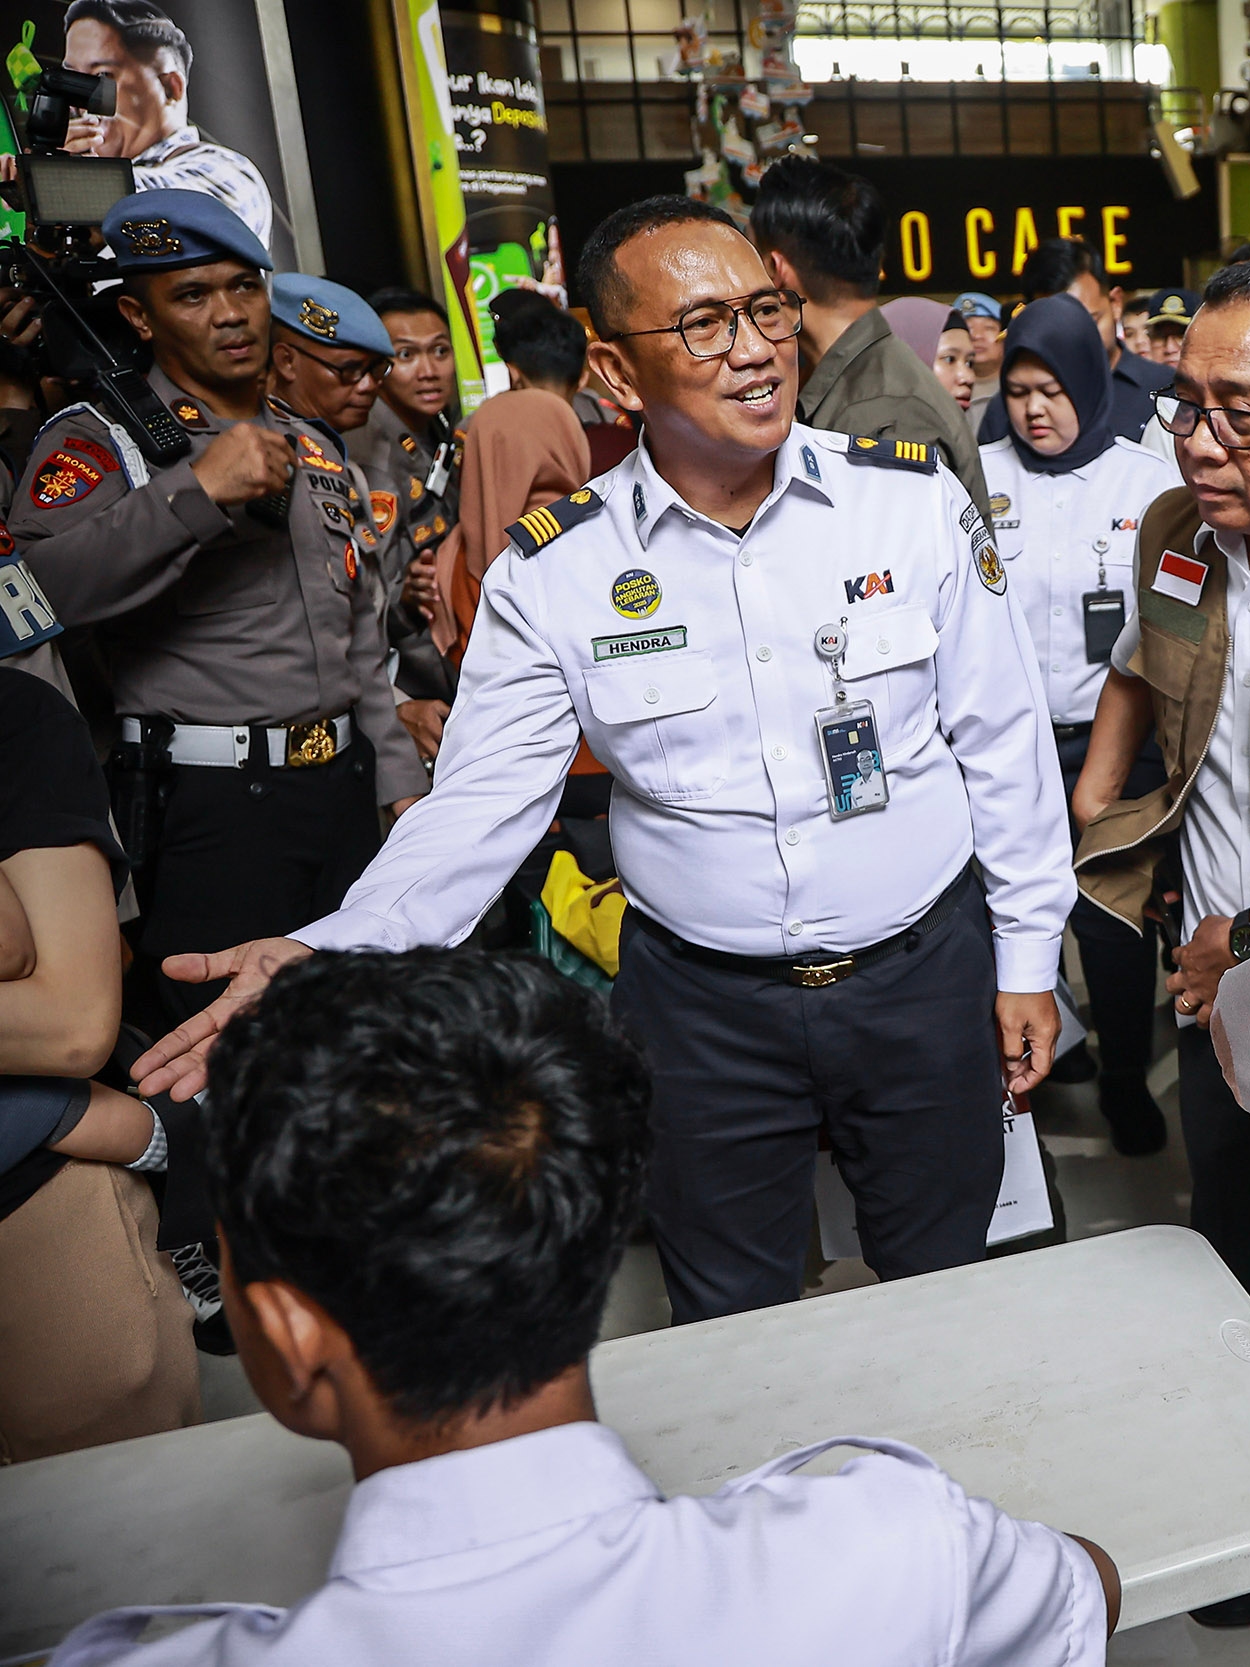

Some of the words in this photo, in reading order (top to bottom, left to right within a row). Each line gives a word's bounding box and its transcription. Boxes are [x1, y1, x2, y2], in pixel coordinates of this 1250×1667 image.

[965, 205, 1133, 280] CAFE
[56, 453, 100, 481] PROPAM
[615, 575, 652, 594] POSKO
[615, 583, 658, 603] ANGKUTAN
[844, 569, 895, 604] KAI
[620, 590, 656, 606] LEBARAN
[609, 636, 672, 654] HENDRA
[821, 636, 838, 645] KAI
